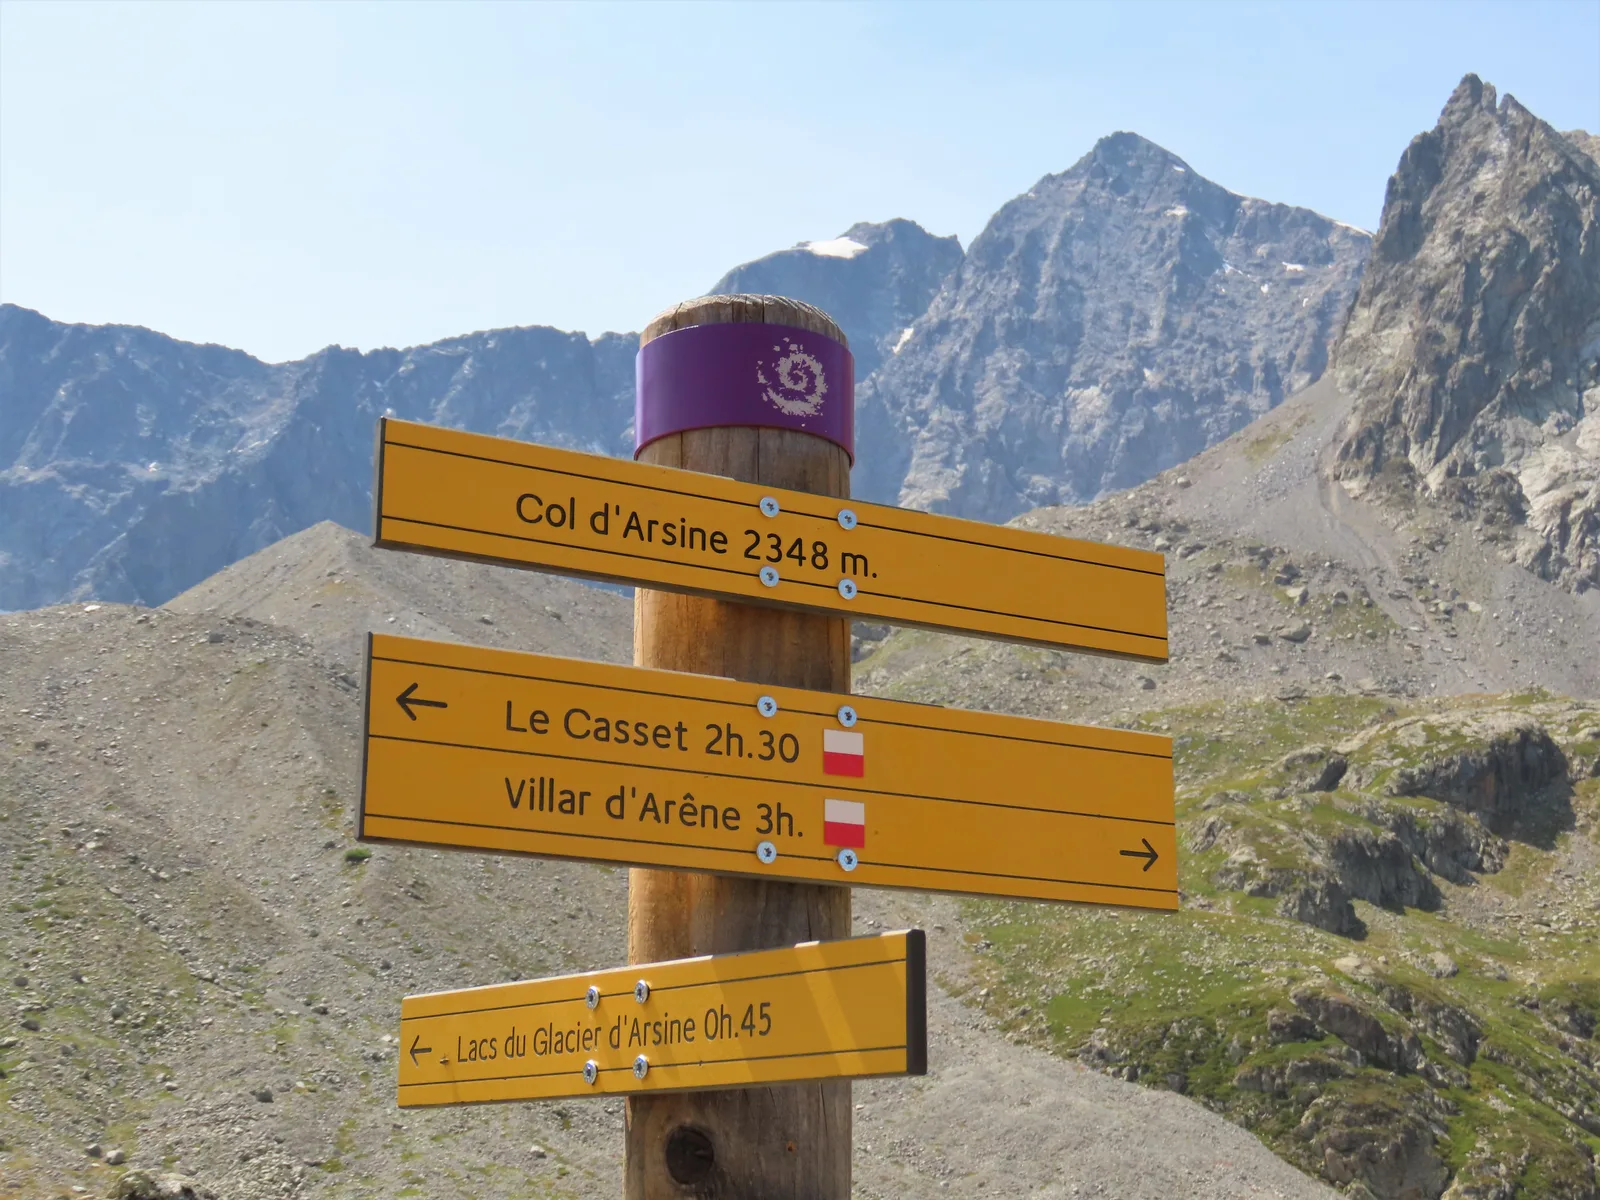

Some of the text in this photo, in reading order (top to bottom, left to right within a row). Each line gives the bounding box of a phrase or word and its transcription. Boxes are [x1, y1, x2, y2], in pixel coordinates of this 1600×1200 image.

[516, 493, 878, 579] Col d'Arsine 2348 m.
[505, 700, 800, 764] Le Casset 2h.30
[504, 776, 803, 838] Villar d'Arêne 3h.
[457, 1036, 497, 1063] Lacs
[504, 1026, 526, 1058] du
[533, 1021, 602, 1056] Glacier
[609, 1012, 696, 1049] d'Arsine
